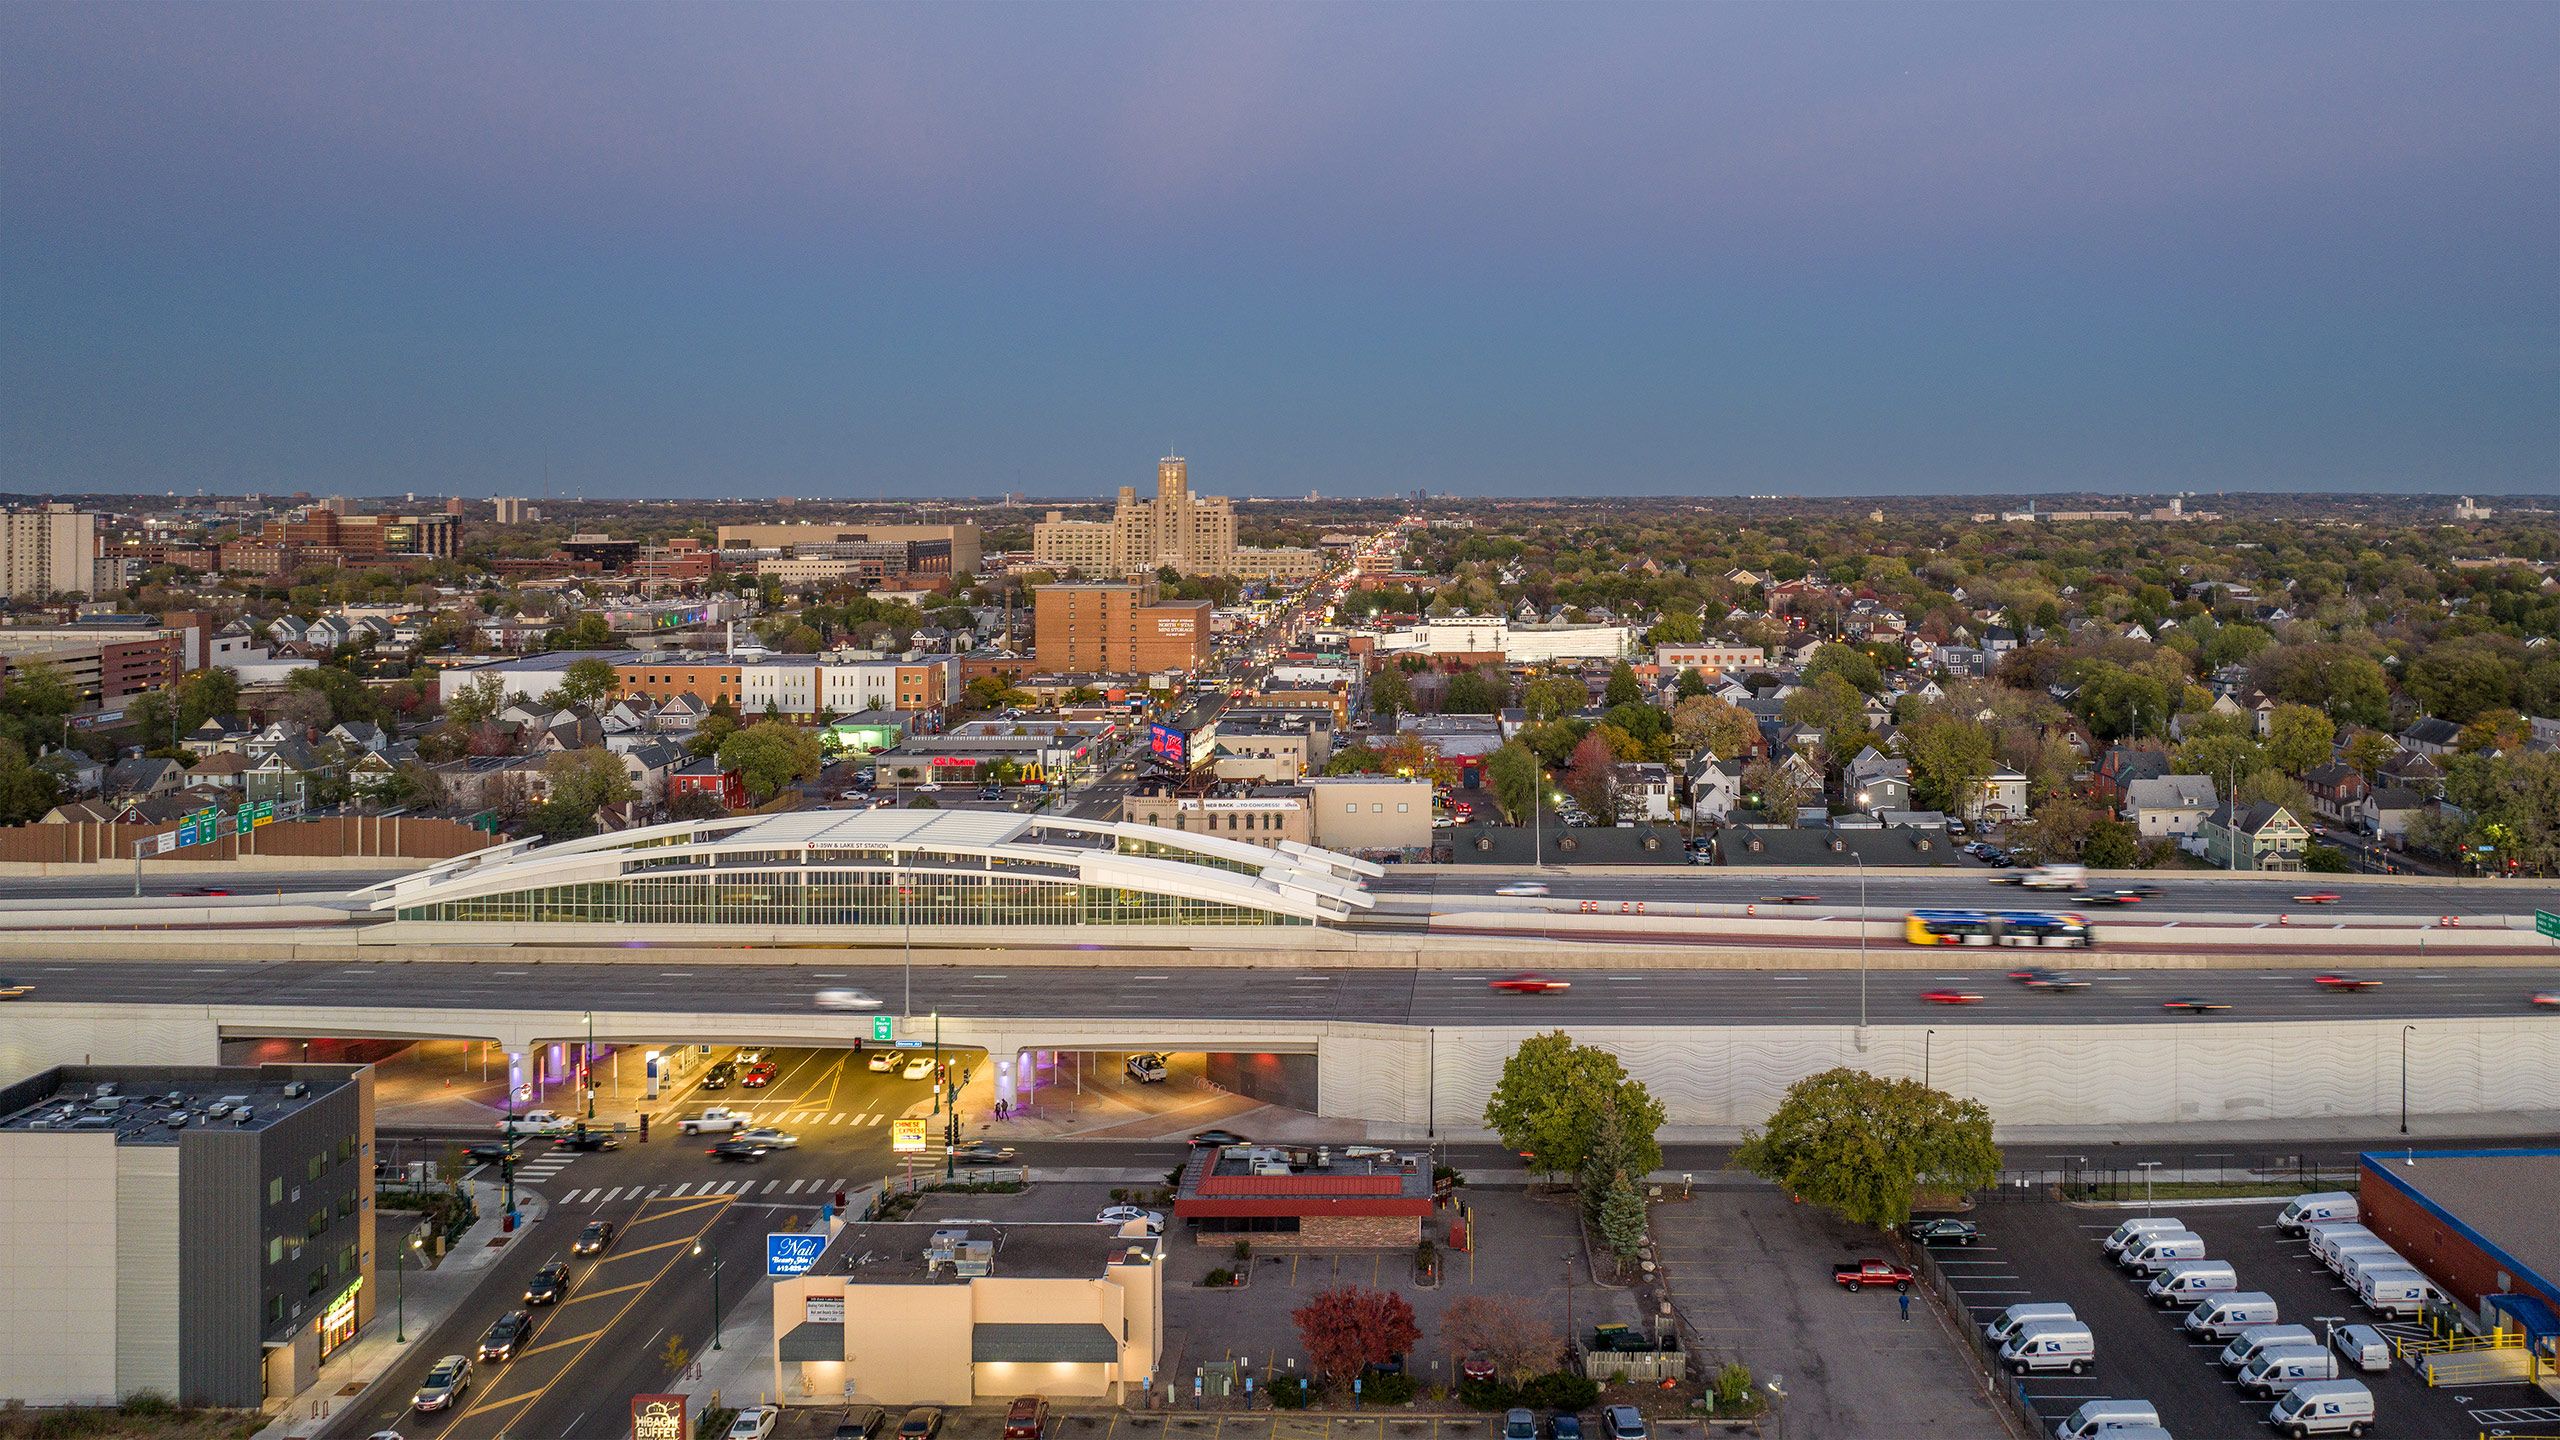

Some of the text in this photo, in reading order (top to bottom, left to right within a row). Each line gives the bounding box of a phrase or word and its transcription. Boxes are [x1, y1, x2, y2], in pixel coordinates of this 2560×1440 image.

[933, 757, 977, 767] CSL Plasma
[777, 1237, 818, 1257] Nail
[636, 1416, 679, 1427] HIBACHI
[637, 1427, 677, 1438] BUFFET
